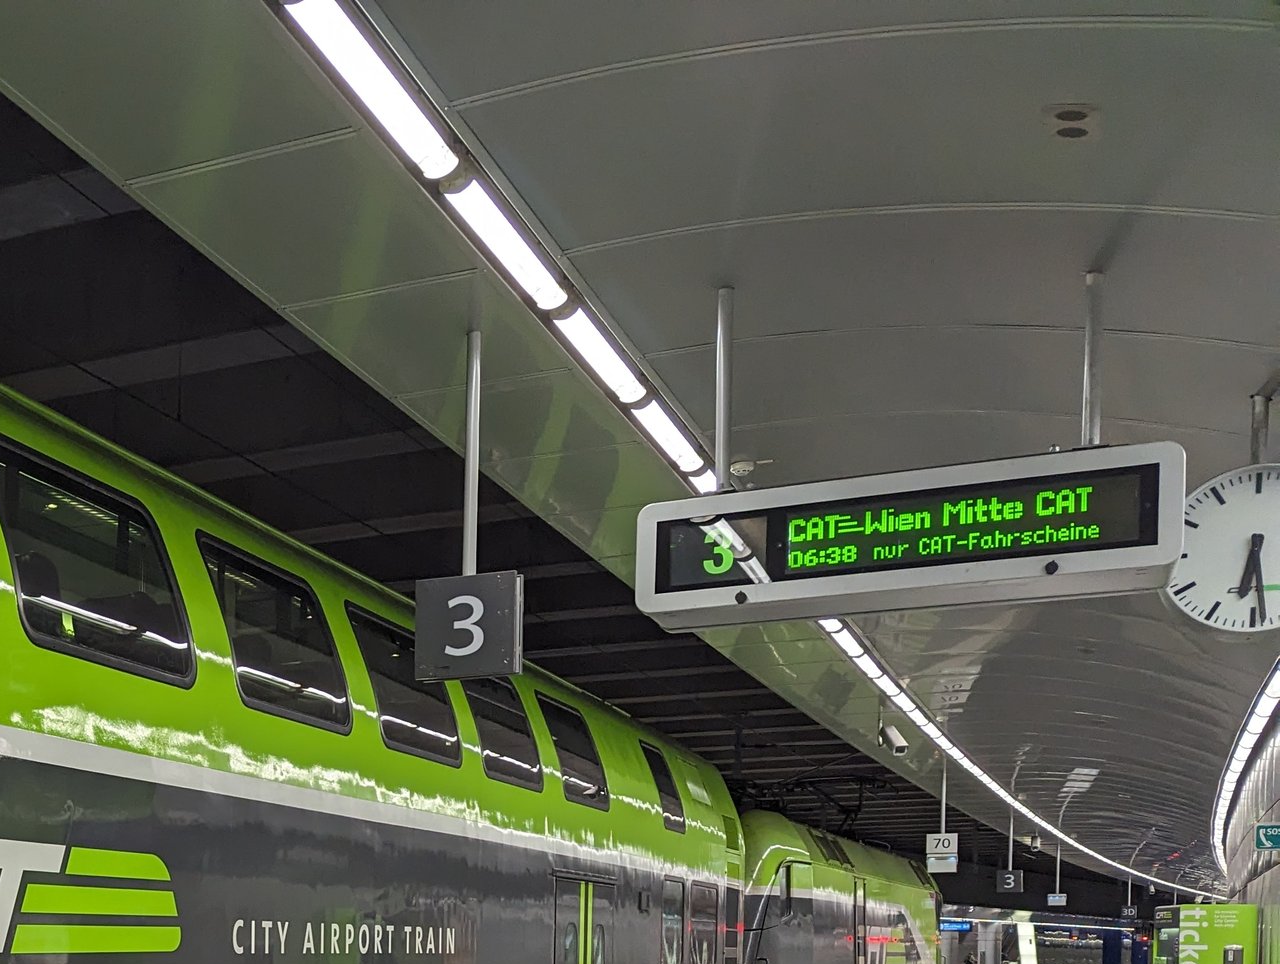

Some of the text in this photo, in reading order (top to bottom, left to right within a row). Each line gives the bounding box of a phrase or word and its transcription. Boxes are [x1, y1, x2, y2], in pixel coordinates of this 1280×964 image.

[864, 508, 931, 535] Wien
[942, 497, 1024, 527] Mitte
[1036, 486, 1093, 517] CAT
[703, 529, 734, 575] 3
[788, 522, 1100, 569] 06:38 nur CAT-Fahrscheine
[444, 595, 485, 657] 3
[933, 837, 951, 849] 70
[1003, 874, 1015, 888] 3
[232, 919, 456, 955] CITY AIRPORT TRAIN
